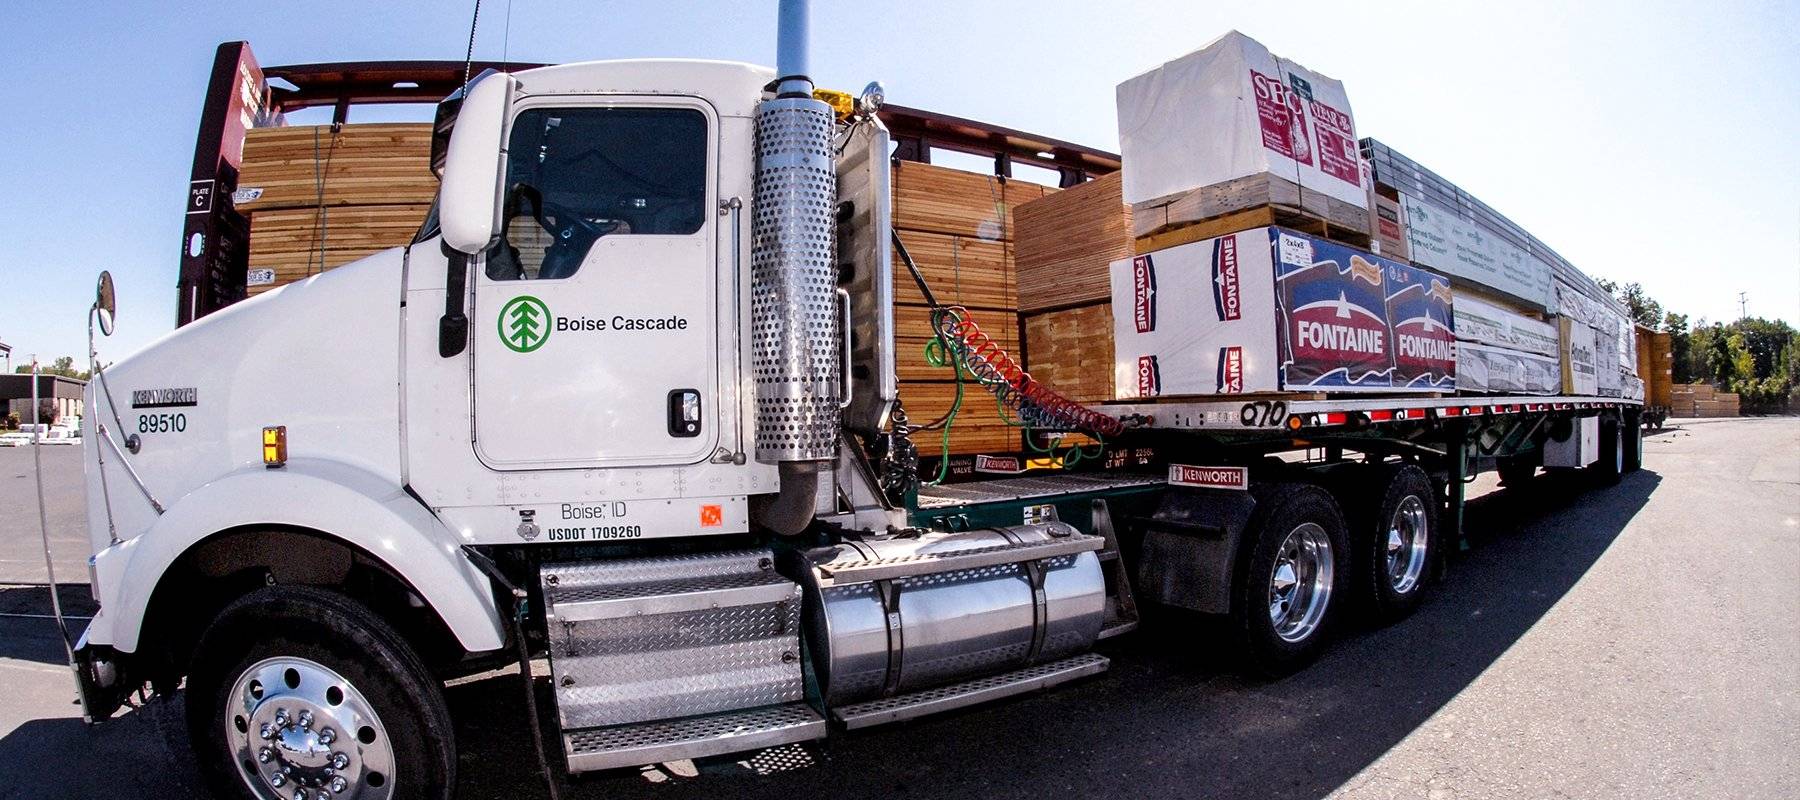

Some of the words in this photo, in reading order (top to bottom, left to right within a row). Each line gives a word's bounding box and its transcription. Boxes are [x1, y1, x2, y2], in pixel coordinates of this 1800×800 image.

[1254, 75, 1302, 115] SBC
[192, 188, 209, 196] PLATE
[195, 195, 204, 207] C
[1225, 238, 1239, 318] FONTAINE
[1135, 259, 1147, 331] FONTAINE
[556, 317, 606, 331] Boise
[611, 315, 688, 330] Cascade
[1297, 320, 1384, 354] FONTAINE
[1399, 334, 1456, 362] FONTAINE
[132, 388, 197, 405] KENWORTH
[138, 412, 187, 433] 89510
[937, 458, 972, 468] RAINING
[952, 466, 972, 474] VALVE
[1184, 469, 1241, 483] KENWORTH
[561, 502, 606, 520] Boise,
[611, 501, 627, 518] ID
[548, 527, 586, 540] USDOT
[591, 525, 641, 539] 1709260
